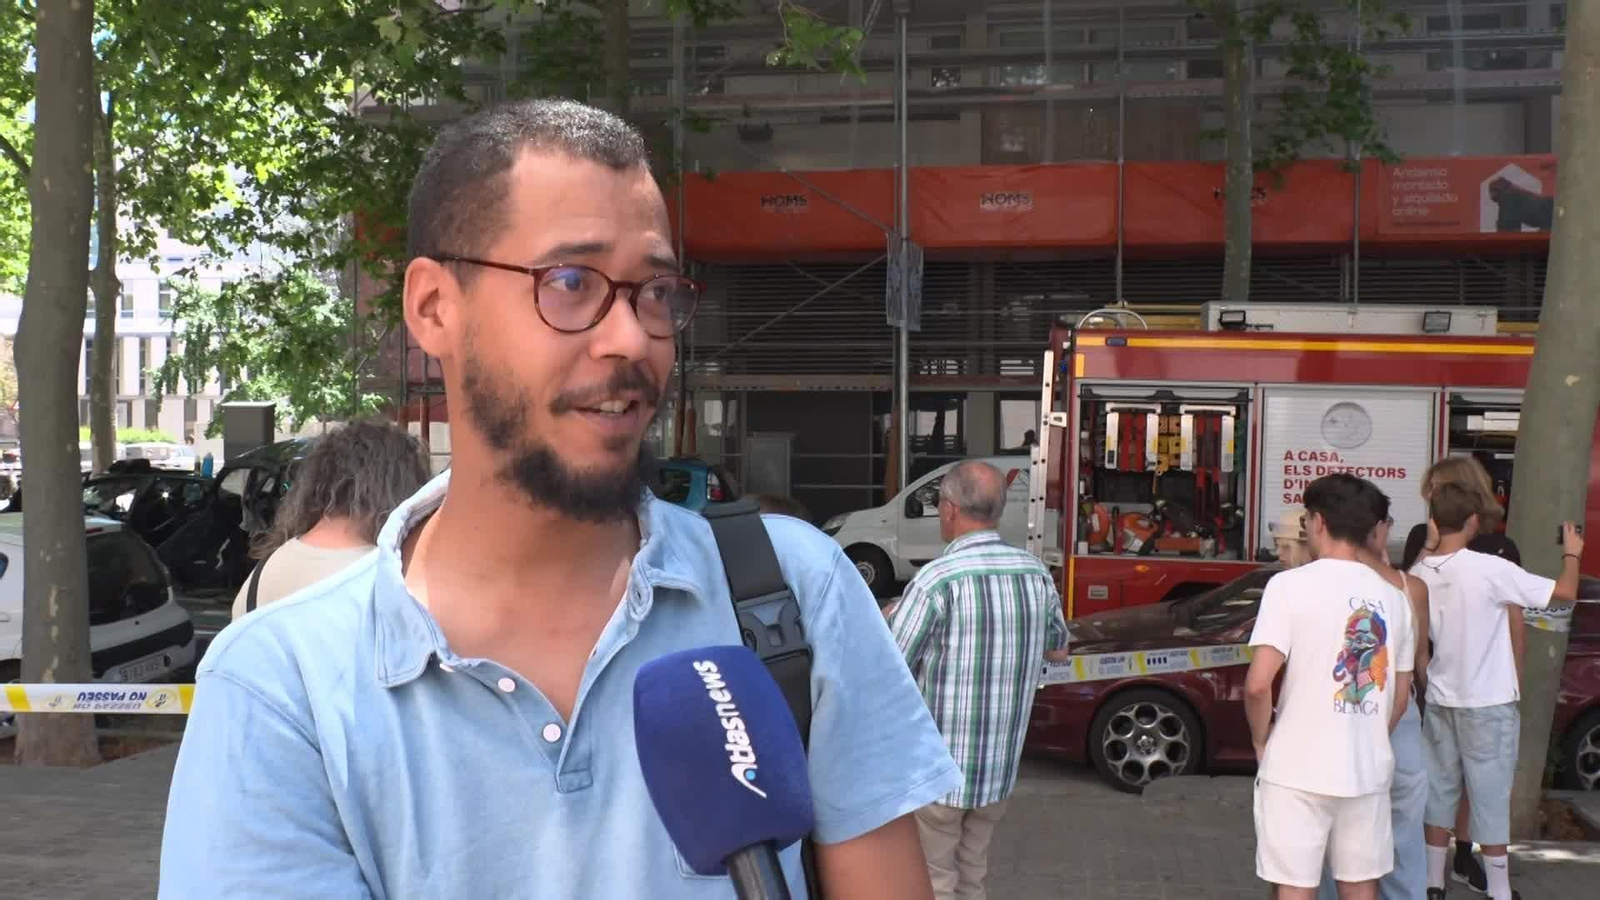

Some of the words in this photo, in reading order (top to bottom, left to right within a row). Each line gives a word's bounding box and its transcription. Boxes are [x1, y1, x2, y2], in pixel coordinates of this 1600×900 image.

[760, 194, 808, 207] HOMS
[980, 193, 1031, 206] HOMS
[1284, 450, 1294, 461] A
[1298, 451, 1344, 463] CASA,
[1284, 465, 1312, 476] ELS
[1348, 596, 1386, 614] CASA
[77, 692, 126, 701] PASSEU
[129, 692, 147, 701] NO
[693, 660, 767, 798] Atlasnews
